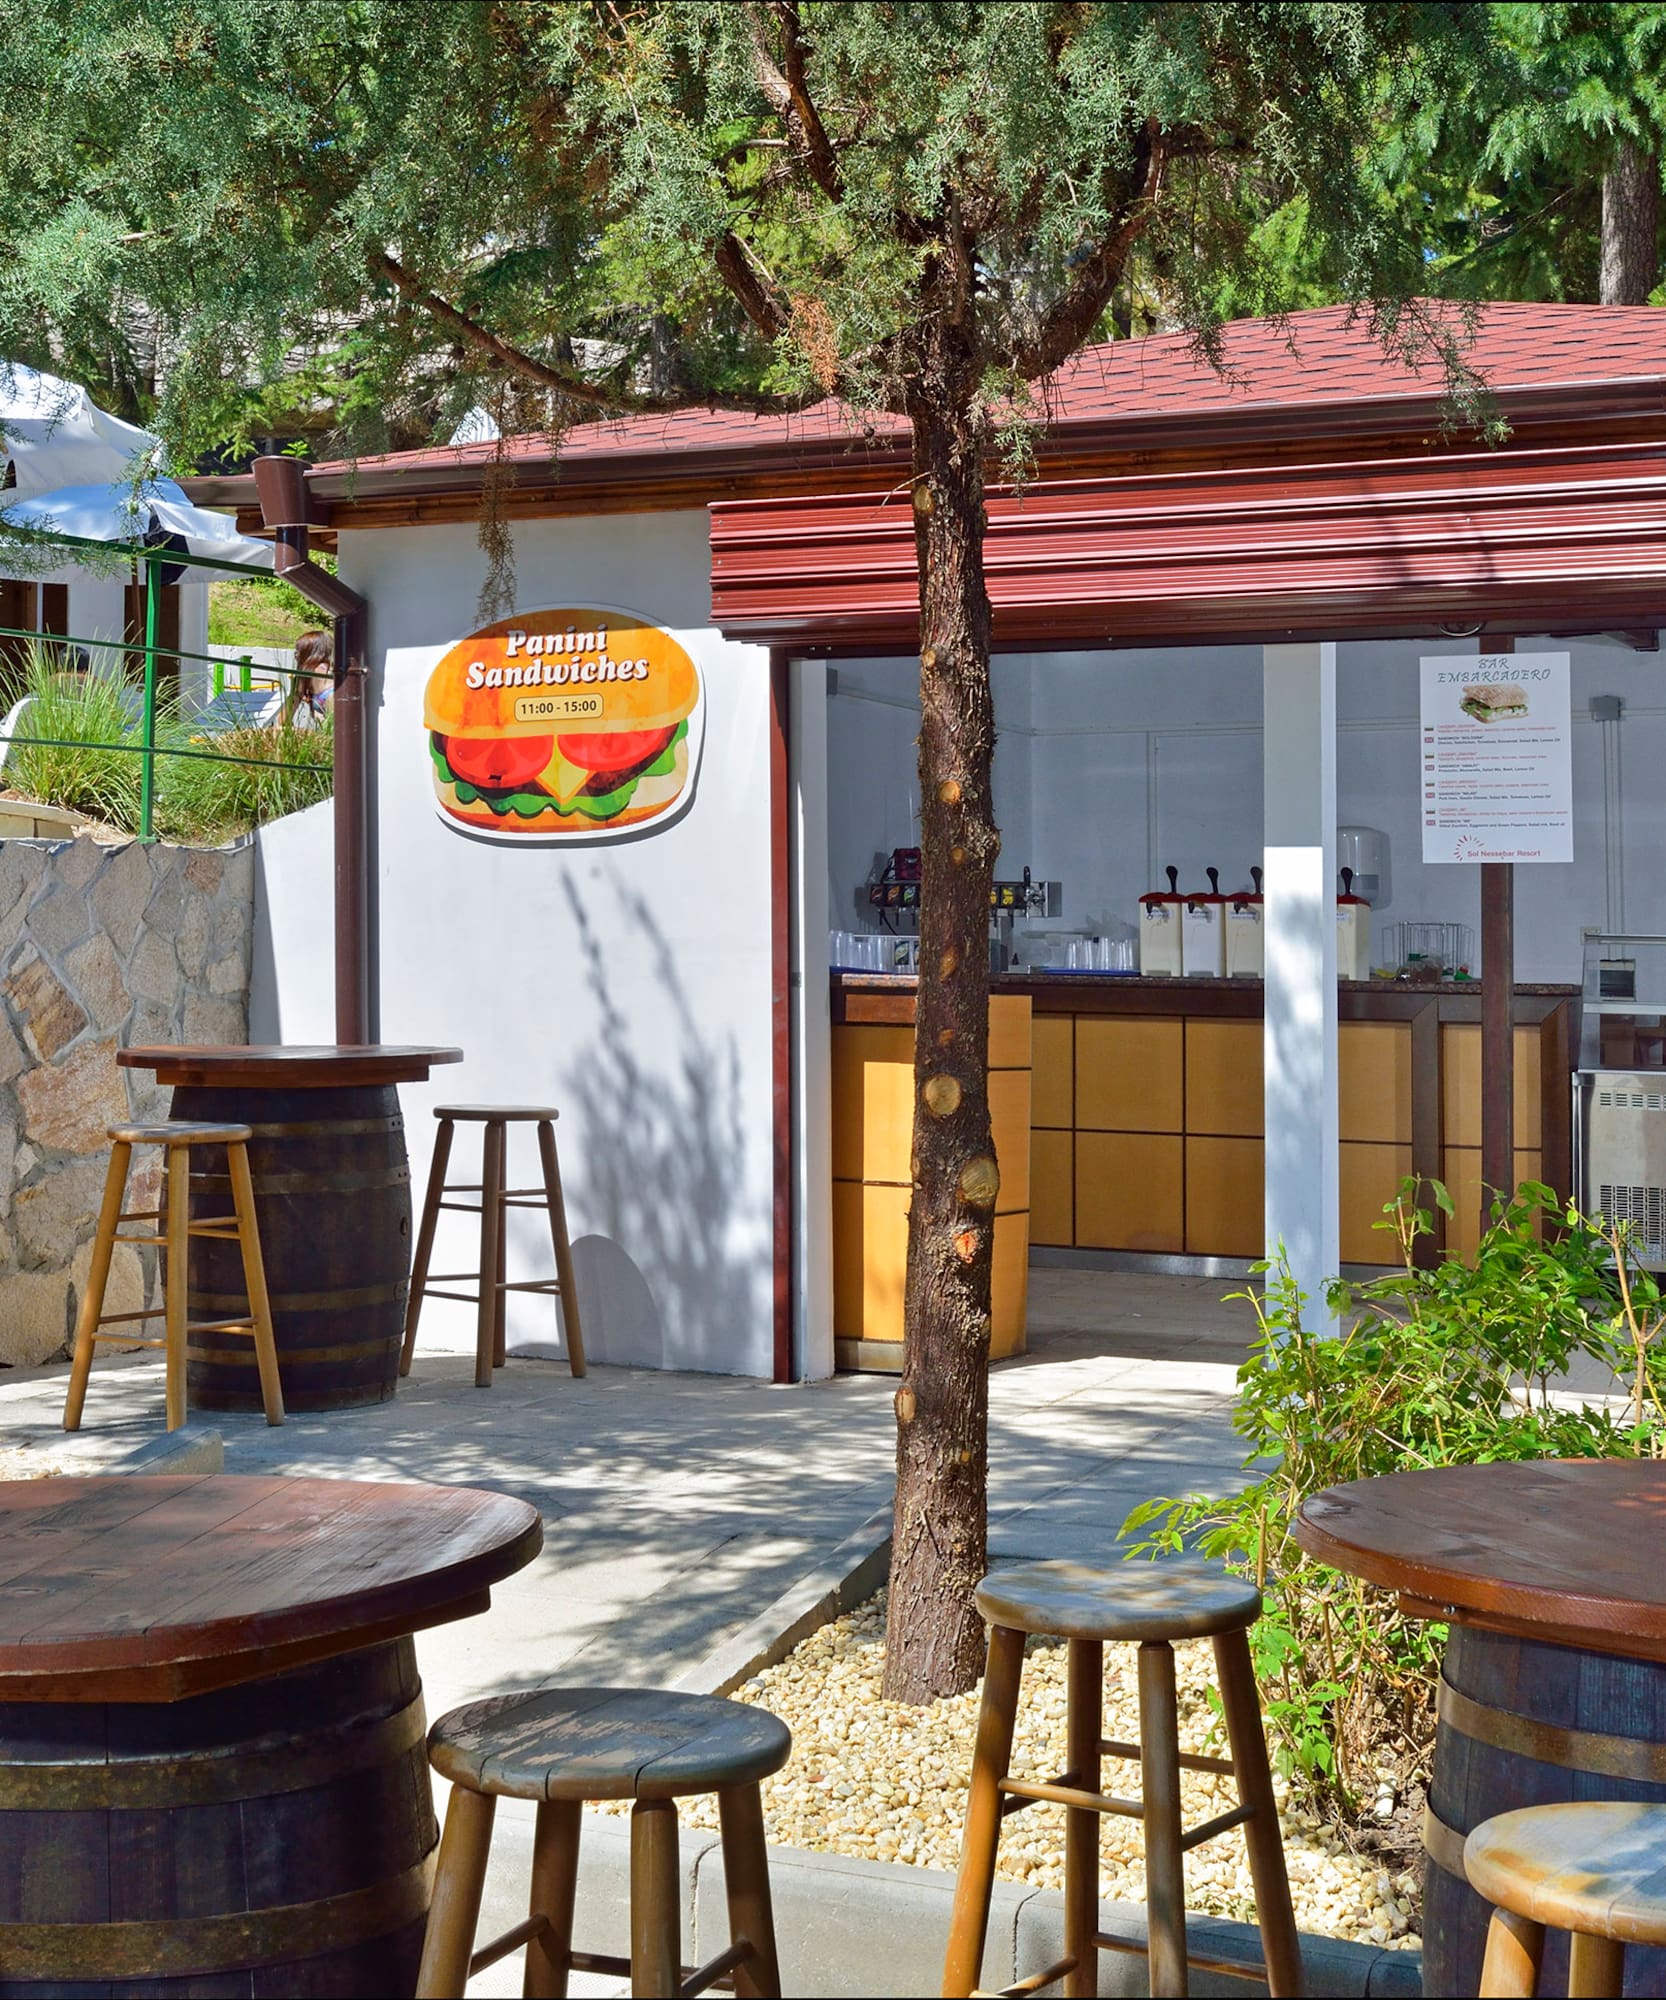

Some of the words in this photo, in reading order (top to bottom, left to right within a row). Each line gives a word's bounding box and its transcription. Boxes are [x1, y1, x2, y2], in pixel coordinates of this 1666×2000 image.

[505, 623, 608, 657] Panini
[1478, 657, 1510, 670] BAR
[465, 655, 650, 691] Sandwiches
[1437, 669, 1551, 683] EMBARCADERO
[521, 702, 555, 715] 11:00
[564, 700, 597, 713] 15:00
[1517, 849, 1541, 857] Resort
